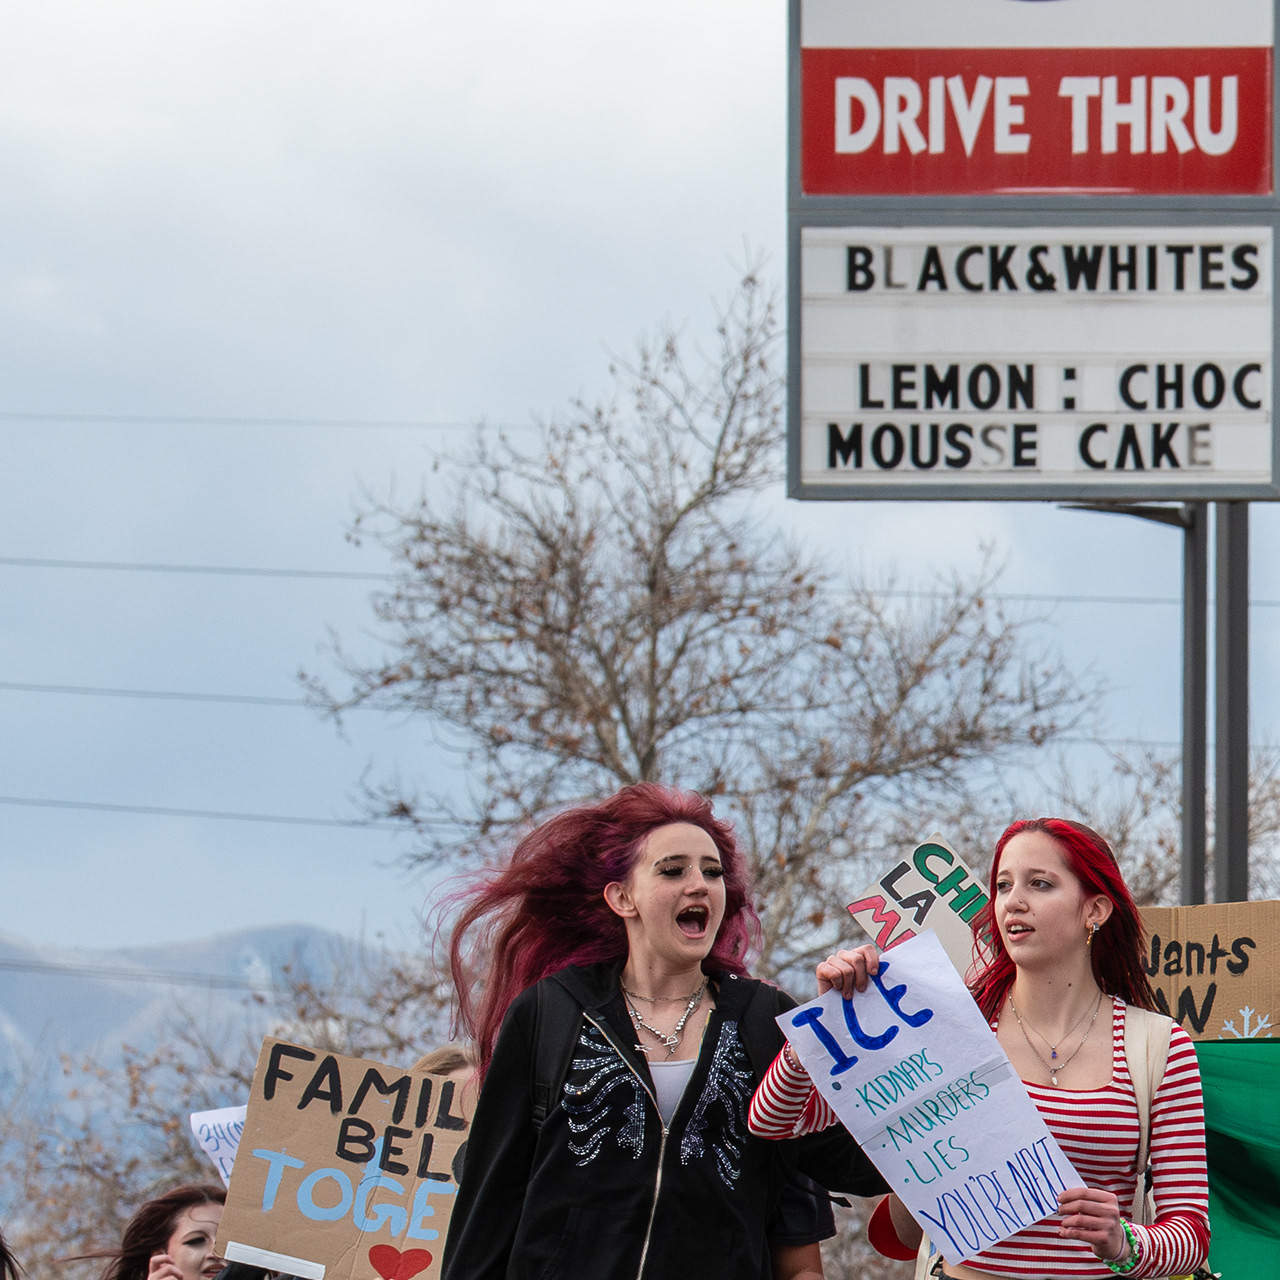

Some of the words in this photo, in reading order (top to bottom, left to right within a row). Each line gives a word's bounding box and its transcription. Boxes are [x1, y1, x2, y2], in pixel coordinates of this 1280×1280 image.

[834, 75, 1031, 157] DRIVE
[1058, 74, 1239, 156] THRU
[846, 245, 1260, 292] BLACK&WHITES
[860, 363, 1035, 411] LEMON
[1119, 363, 1263, 411] CHOC
[827, 423, 1038, 472] MOUSSE
[1079, 424, 1212, 472] CAKE
[880, 860, 937, 926] LA
[792, 961, 934, 1076] ICE
[856, 1047, 943, 1116] KIDNAPS
[886, 1070, 990, 1151] MURDERS
[906, 1135, 970, 1184] LIES
[1006, 1136, 1068, 1217] NEXT
